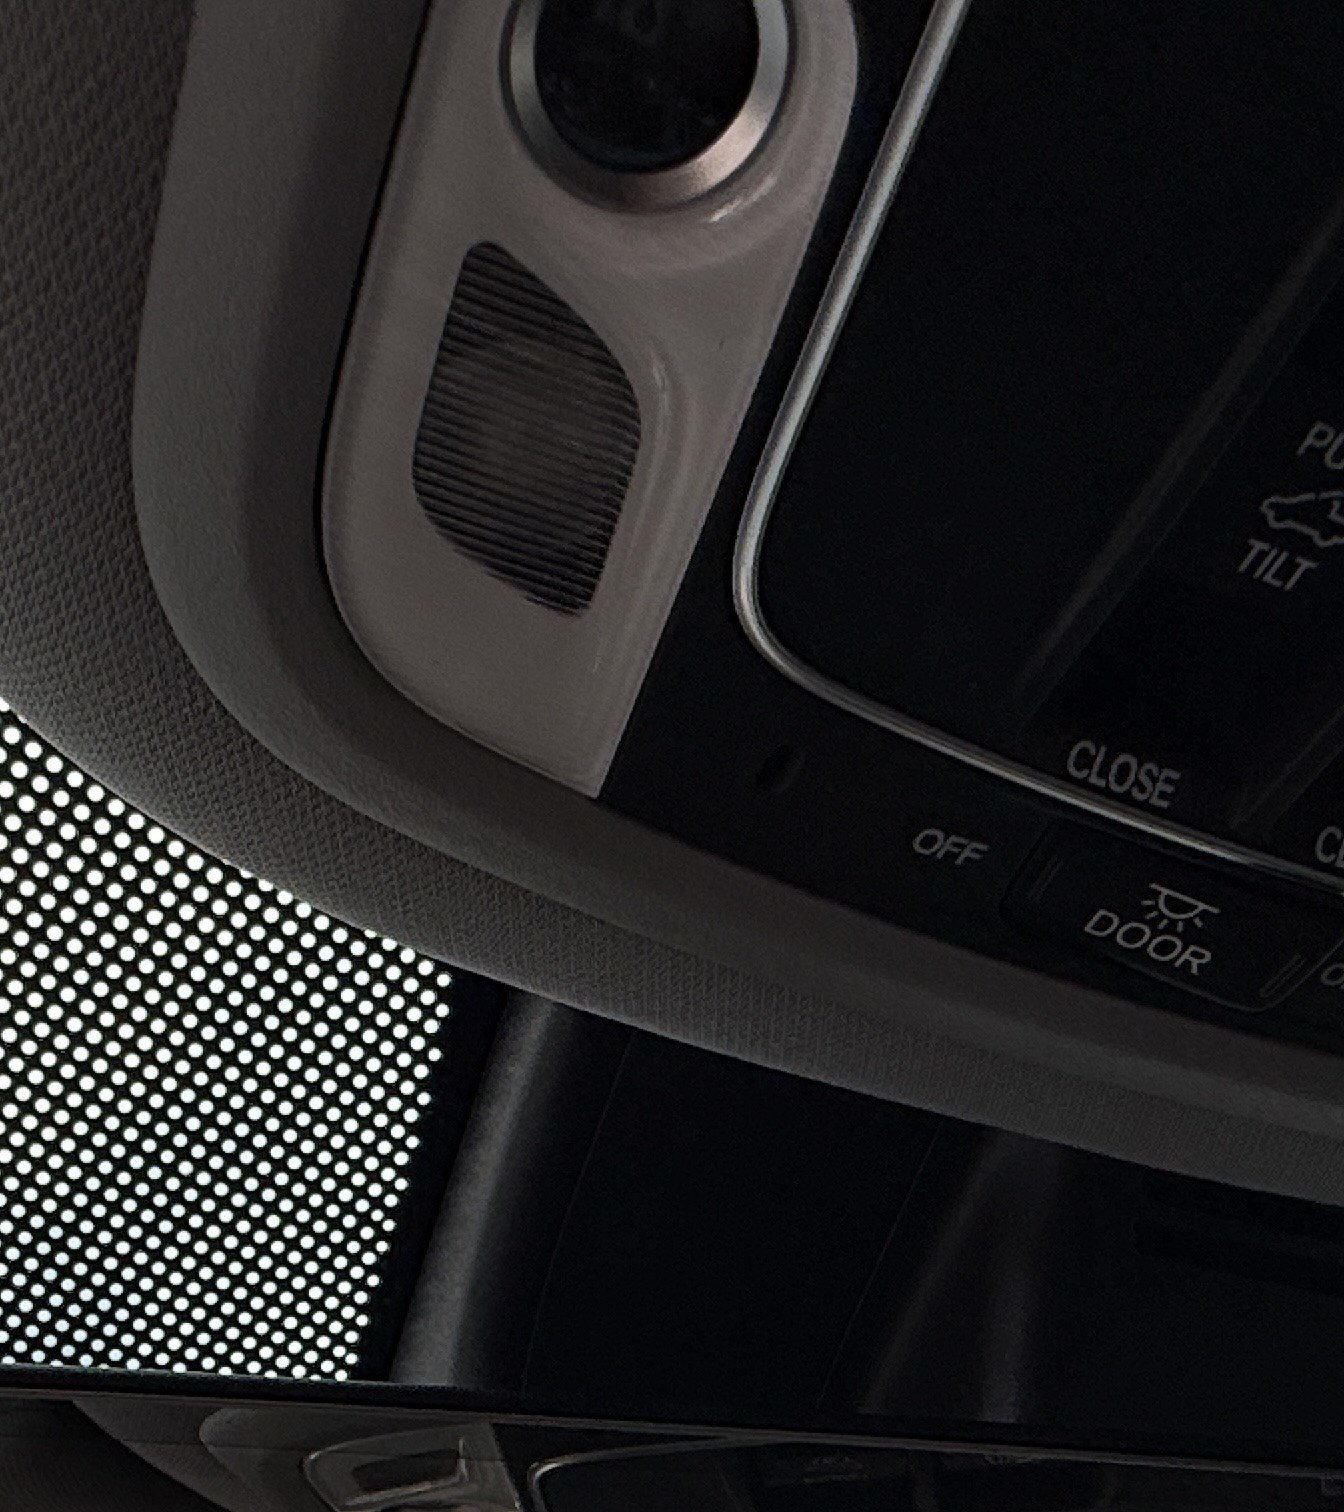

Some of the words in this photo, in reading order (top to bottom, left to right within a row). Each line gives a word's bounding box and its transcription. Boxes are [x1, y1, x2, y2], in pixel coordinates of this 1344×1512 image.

[1238, 538, 1319, 592] TILT
[1068, 740, 1181, 808] CLOSE
[912, 828, 989, 865] OFF
[1084, 909, 1212, 975] DOOR
